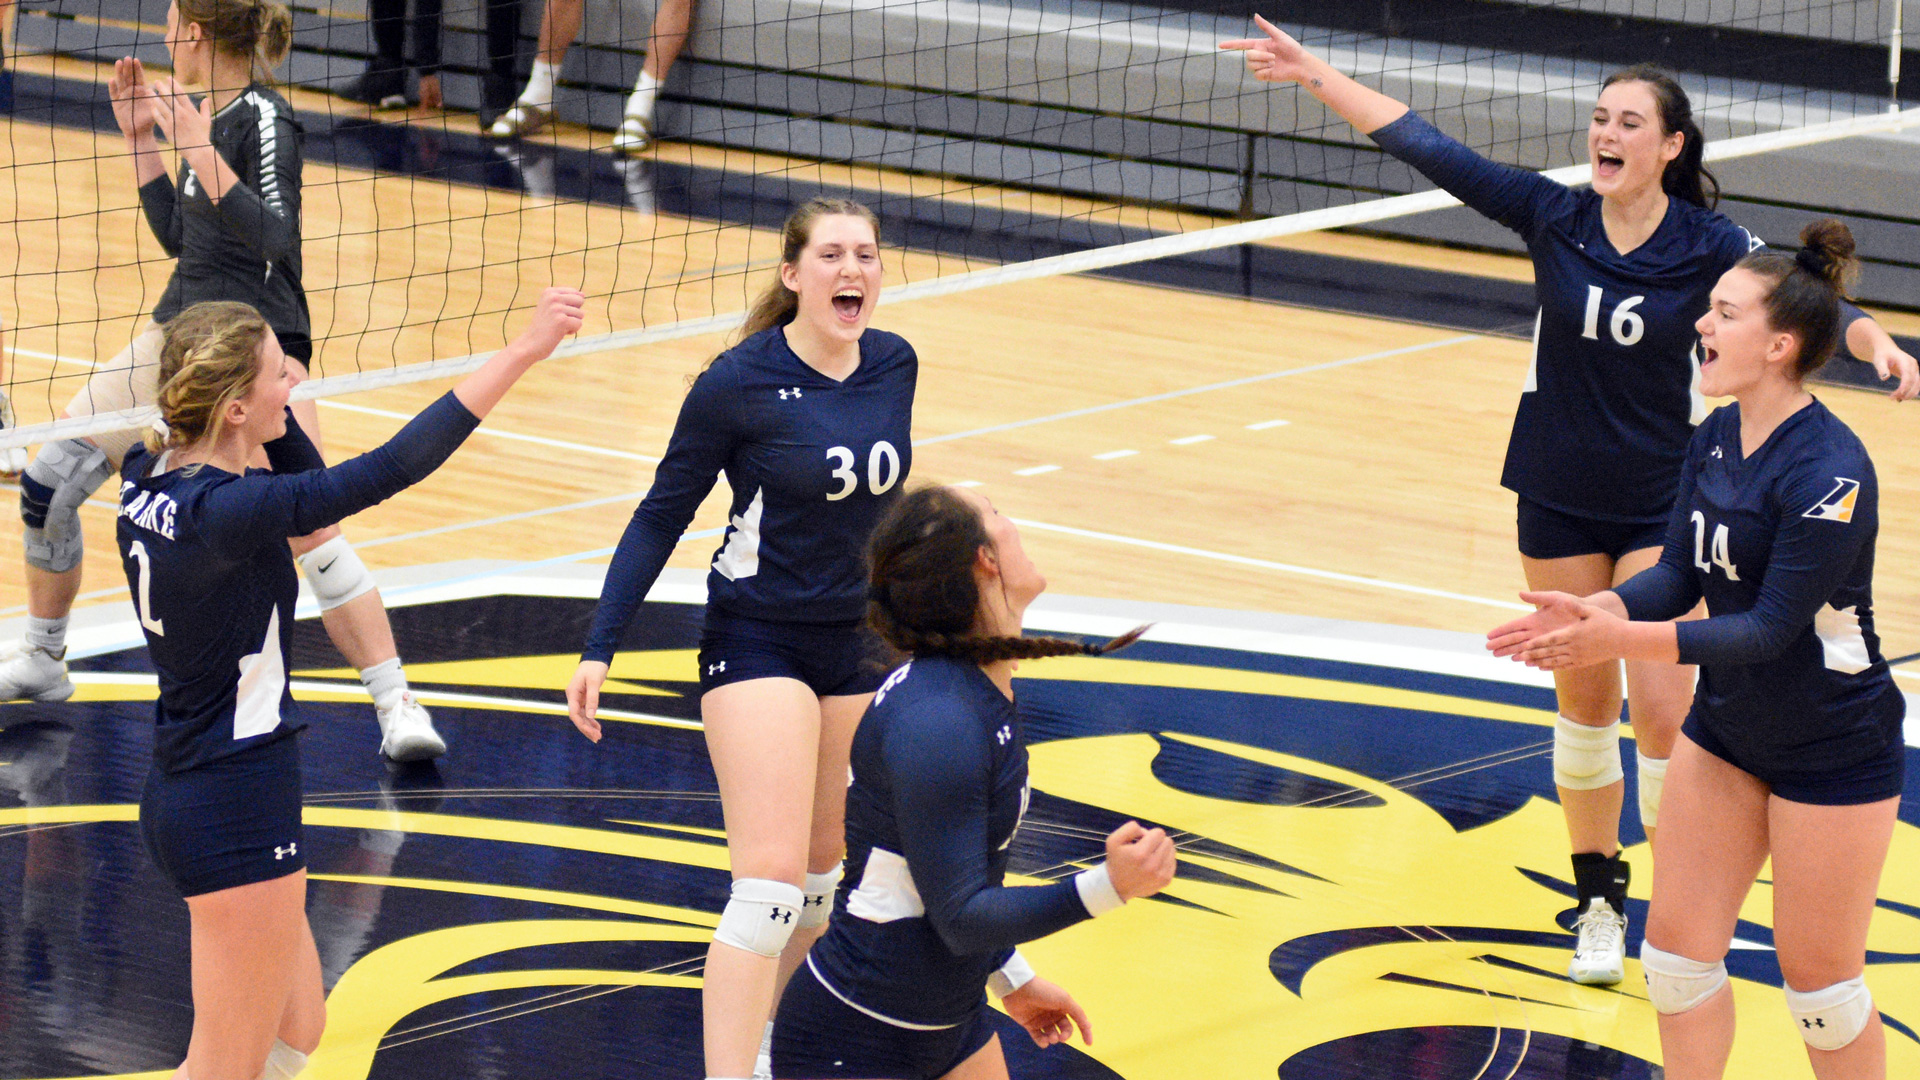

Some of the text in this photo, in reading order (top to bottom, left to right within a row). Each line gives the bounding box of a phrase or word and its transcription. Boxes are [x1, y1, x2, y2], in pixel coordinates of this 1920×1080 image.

[1582, 285, 1644, 345] 16
[826, 441, 900, 501] 30
[1691, 511, 1741, 581] 24
[129, 540, 164, 637] 2
